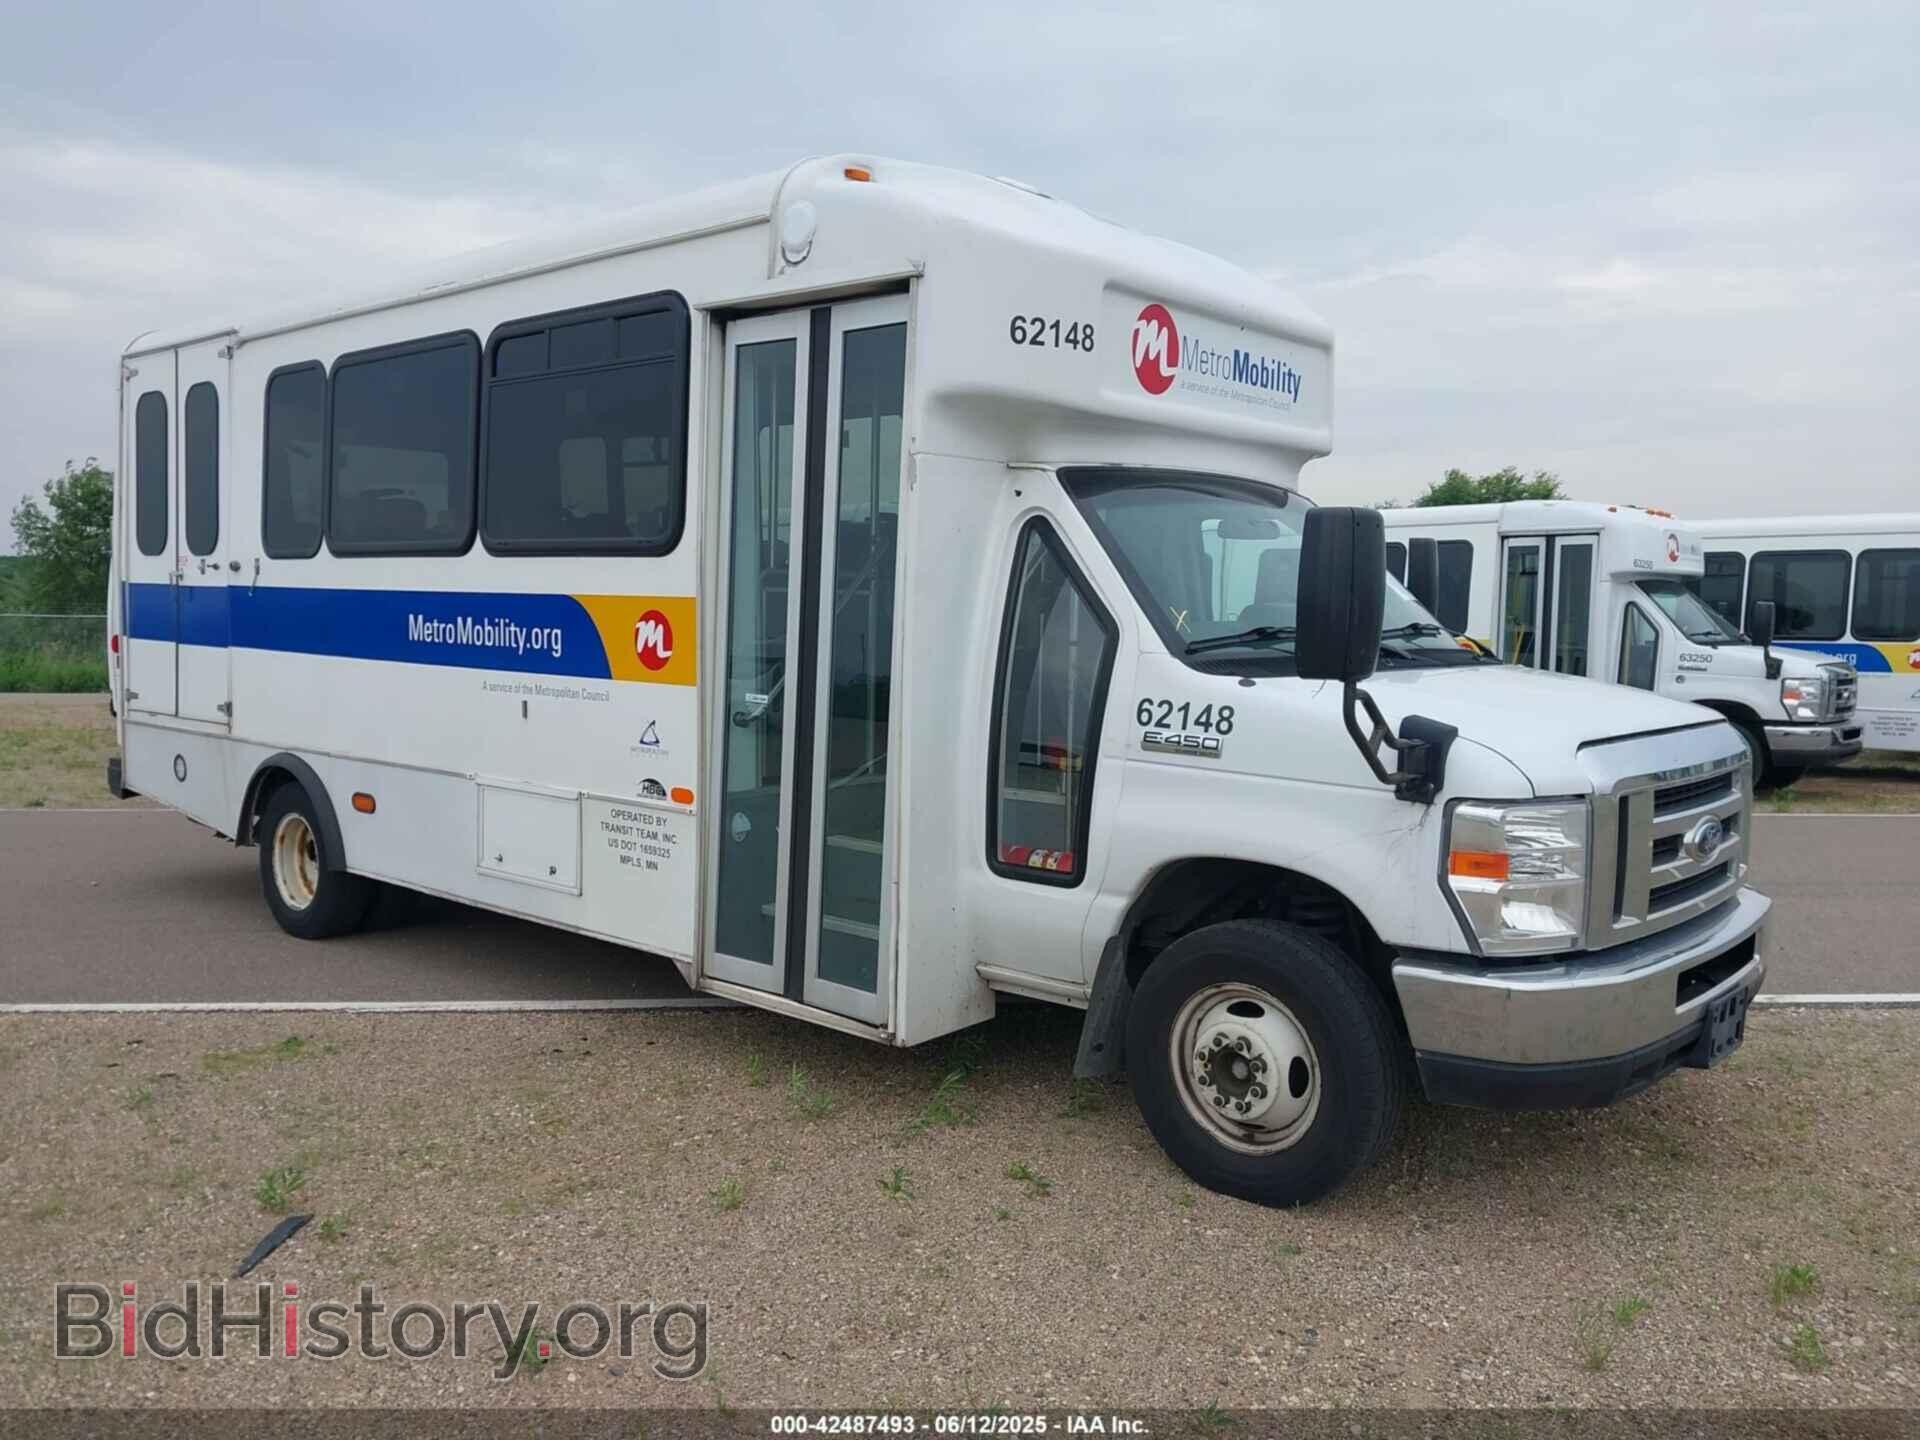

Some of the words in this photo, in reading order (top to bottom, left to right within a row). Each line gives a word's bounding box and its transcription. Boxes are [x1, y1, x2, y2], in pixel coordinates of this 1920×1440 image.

[1009, 315, 1095, 352] 62148
[1181, 335, 1302, 404] MetroMobility
[408, 613, 563, 658] MetroMobility.org
[1679, 652, 1713, 664] 63250
[482, 680, 488, 690] A
[489, 683, 512, 693] service
[514, 684, 521, 694] of
[522, 684, 533, 695] the
[534, 683, 580, 699] Metropolitan
[581, 687, 610, 702] Council
[1136, 697, 1235, 736] 62148
[610, 808, 655, 825] OPERATED
[656, 816, 668, 827] BY
[600, 820, 634, 837] TRANSIT
[608, 837, 619, 848] US
[620, 839, 637, 852] DOT
[645, 859, 658, 871] MN
